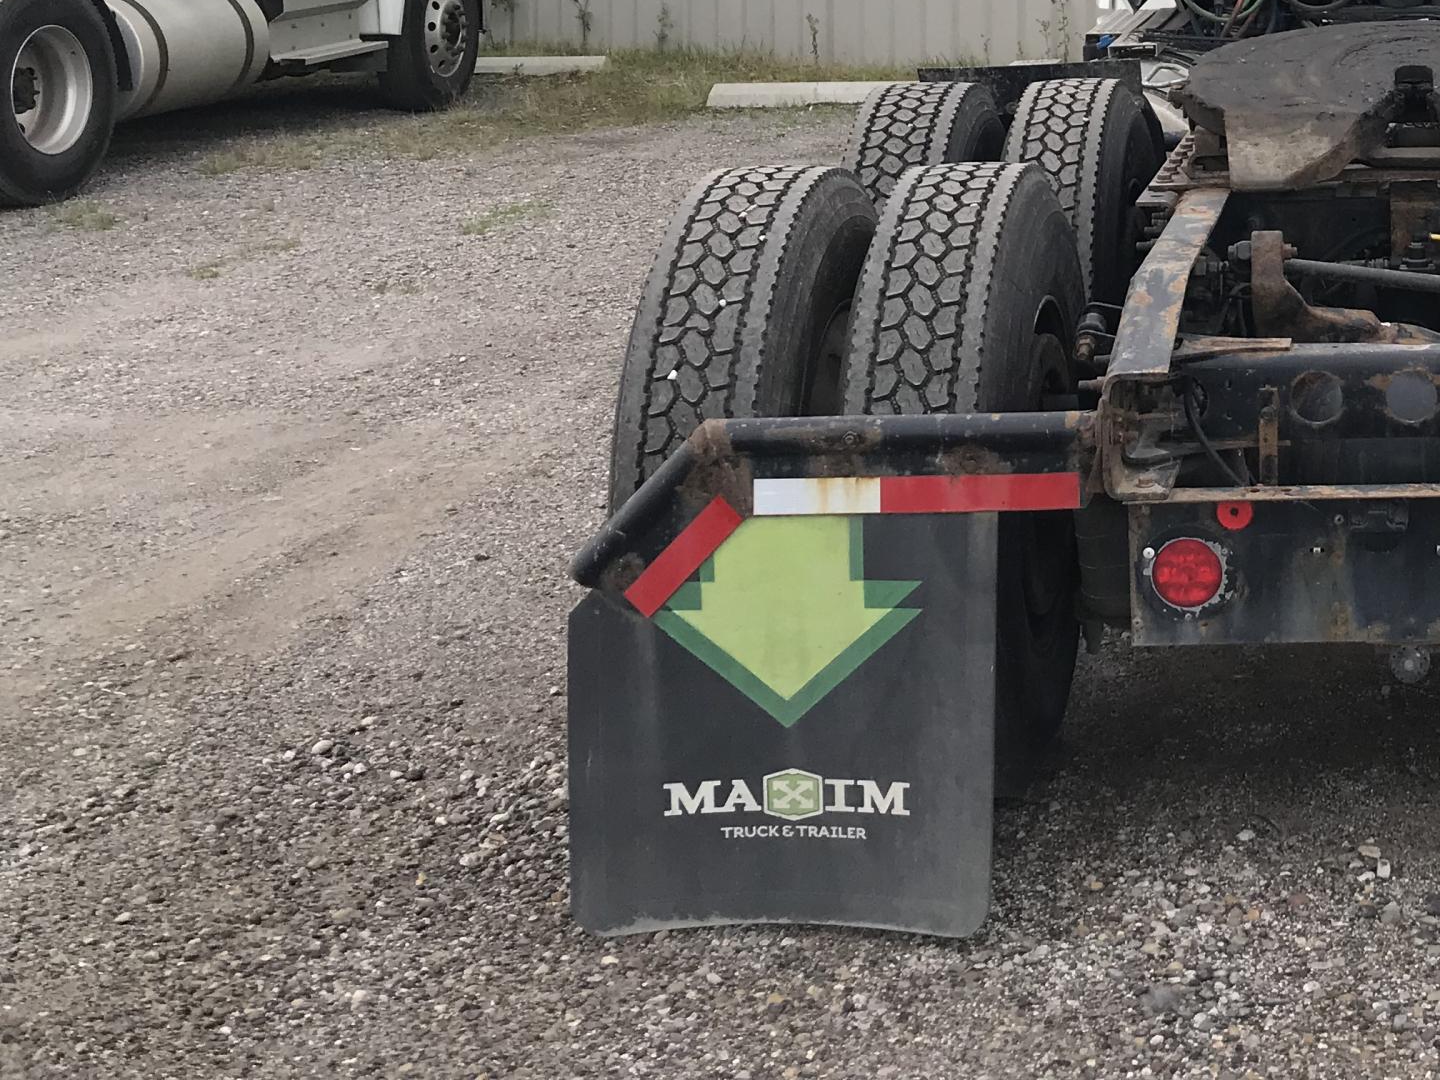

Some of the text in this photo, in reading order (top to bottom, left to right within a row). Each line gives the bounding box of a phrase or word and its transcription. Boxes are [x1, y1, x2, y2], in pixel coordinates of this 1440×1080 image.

[663, 768, 911, 821] MAXIM
[720, 825, 867, 840] TRUCK & TRAILER
